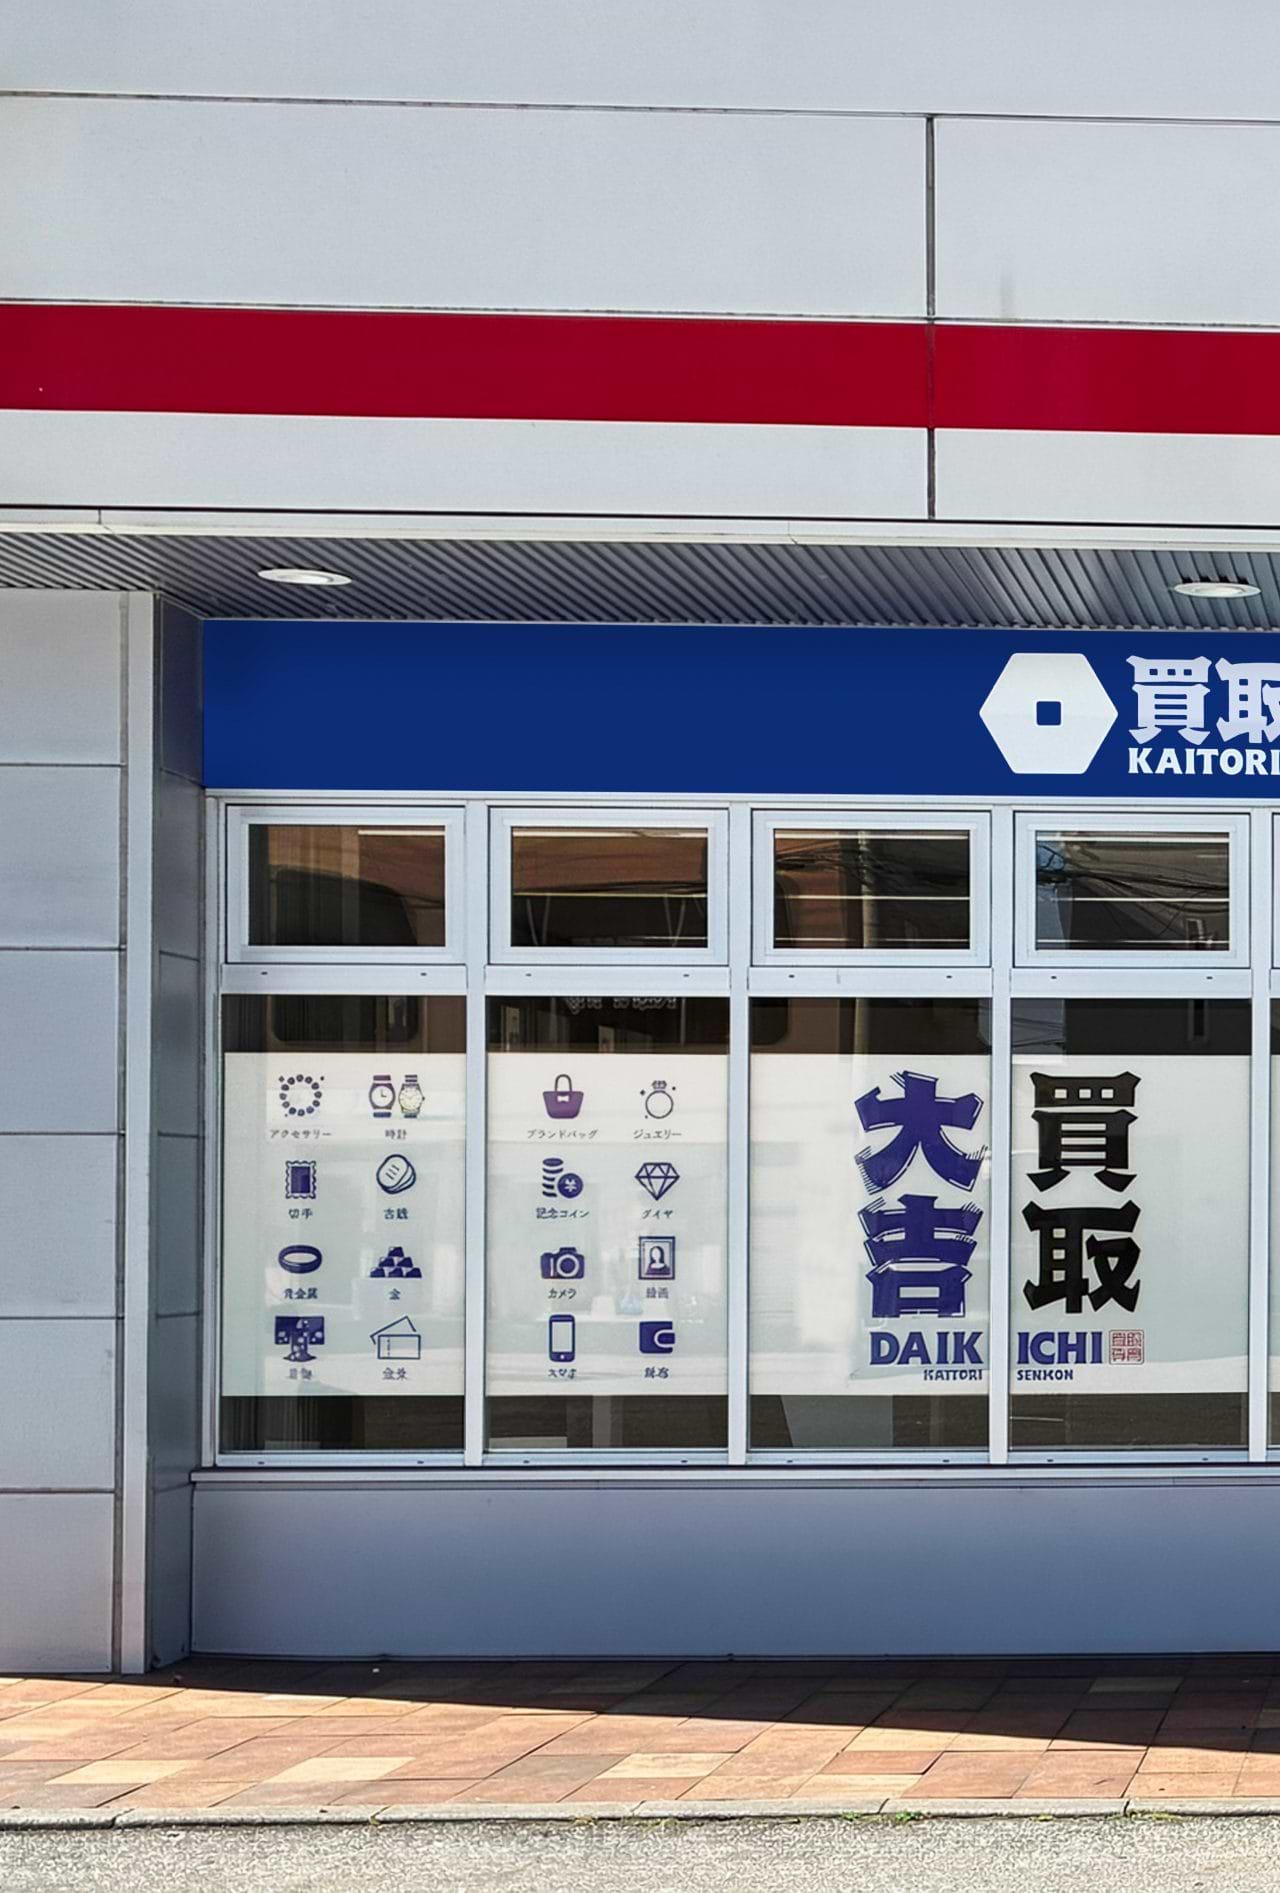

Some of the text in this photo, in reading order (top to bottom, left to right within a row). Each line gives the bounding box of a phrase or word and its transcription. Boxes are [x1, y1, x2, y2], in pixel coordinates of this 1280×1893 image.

[1128, 748, 1280, 775] KAITORI
[270, 1129, 332, 1139] アクセサリー
[384, 1128, 407, 1140] 時計
[527, 1128, 599, 1140] ブランドバッグ
[633, 1128, 682, 1140] ジュエリー
[854, 1070, 990, 1318] 大吉
[1022, 1071, 1141, 1314] 買取
[535, 1206, 590, 1220] 記念コイン
